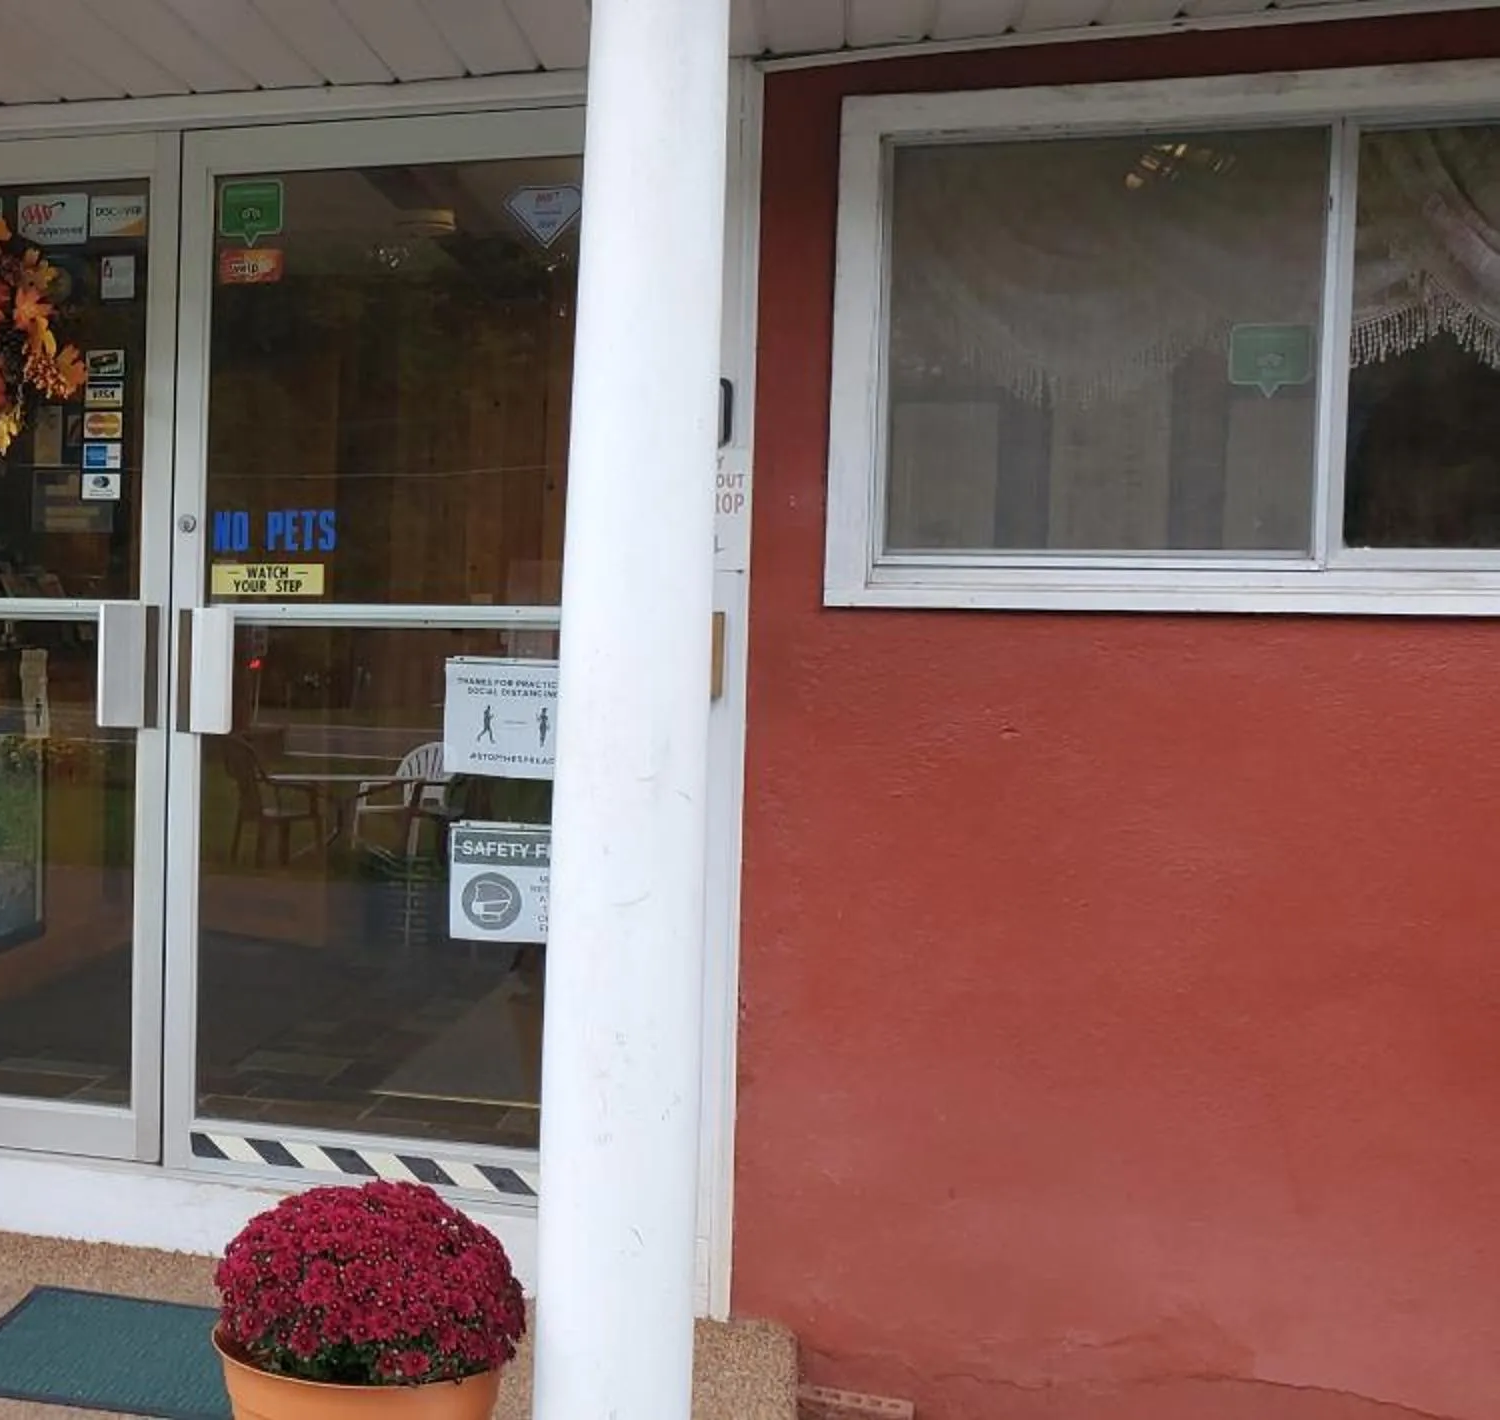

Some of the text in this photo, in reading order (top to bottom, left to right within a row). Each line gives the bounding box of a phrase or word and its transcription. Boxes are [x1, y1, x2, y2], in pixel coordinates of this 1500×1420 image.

[214, 510, 336, 552] NO PETS
[246, 565, 289, 579] WATCH
[233, 580, 303, 593] YOUR STEP
[494, 679, 513, 687] FOR
[467, 686, 498, 696] SOCIAL
[461, 839, 529, 859] SAFETY
